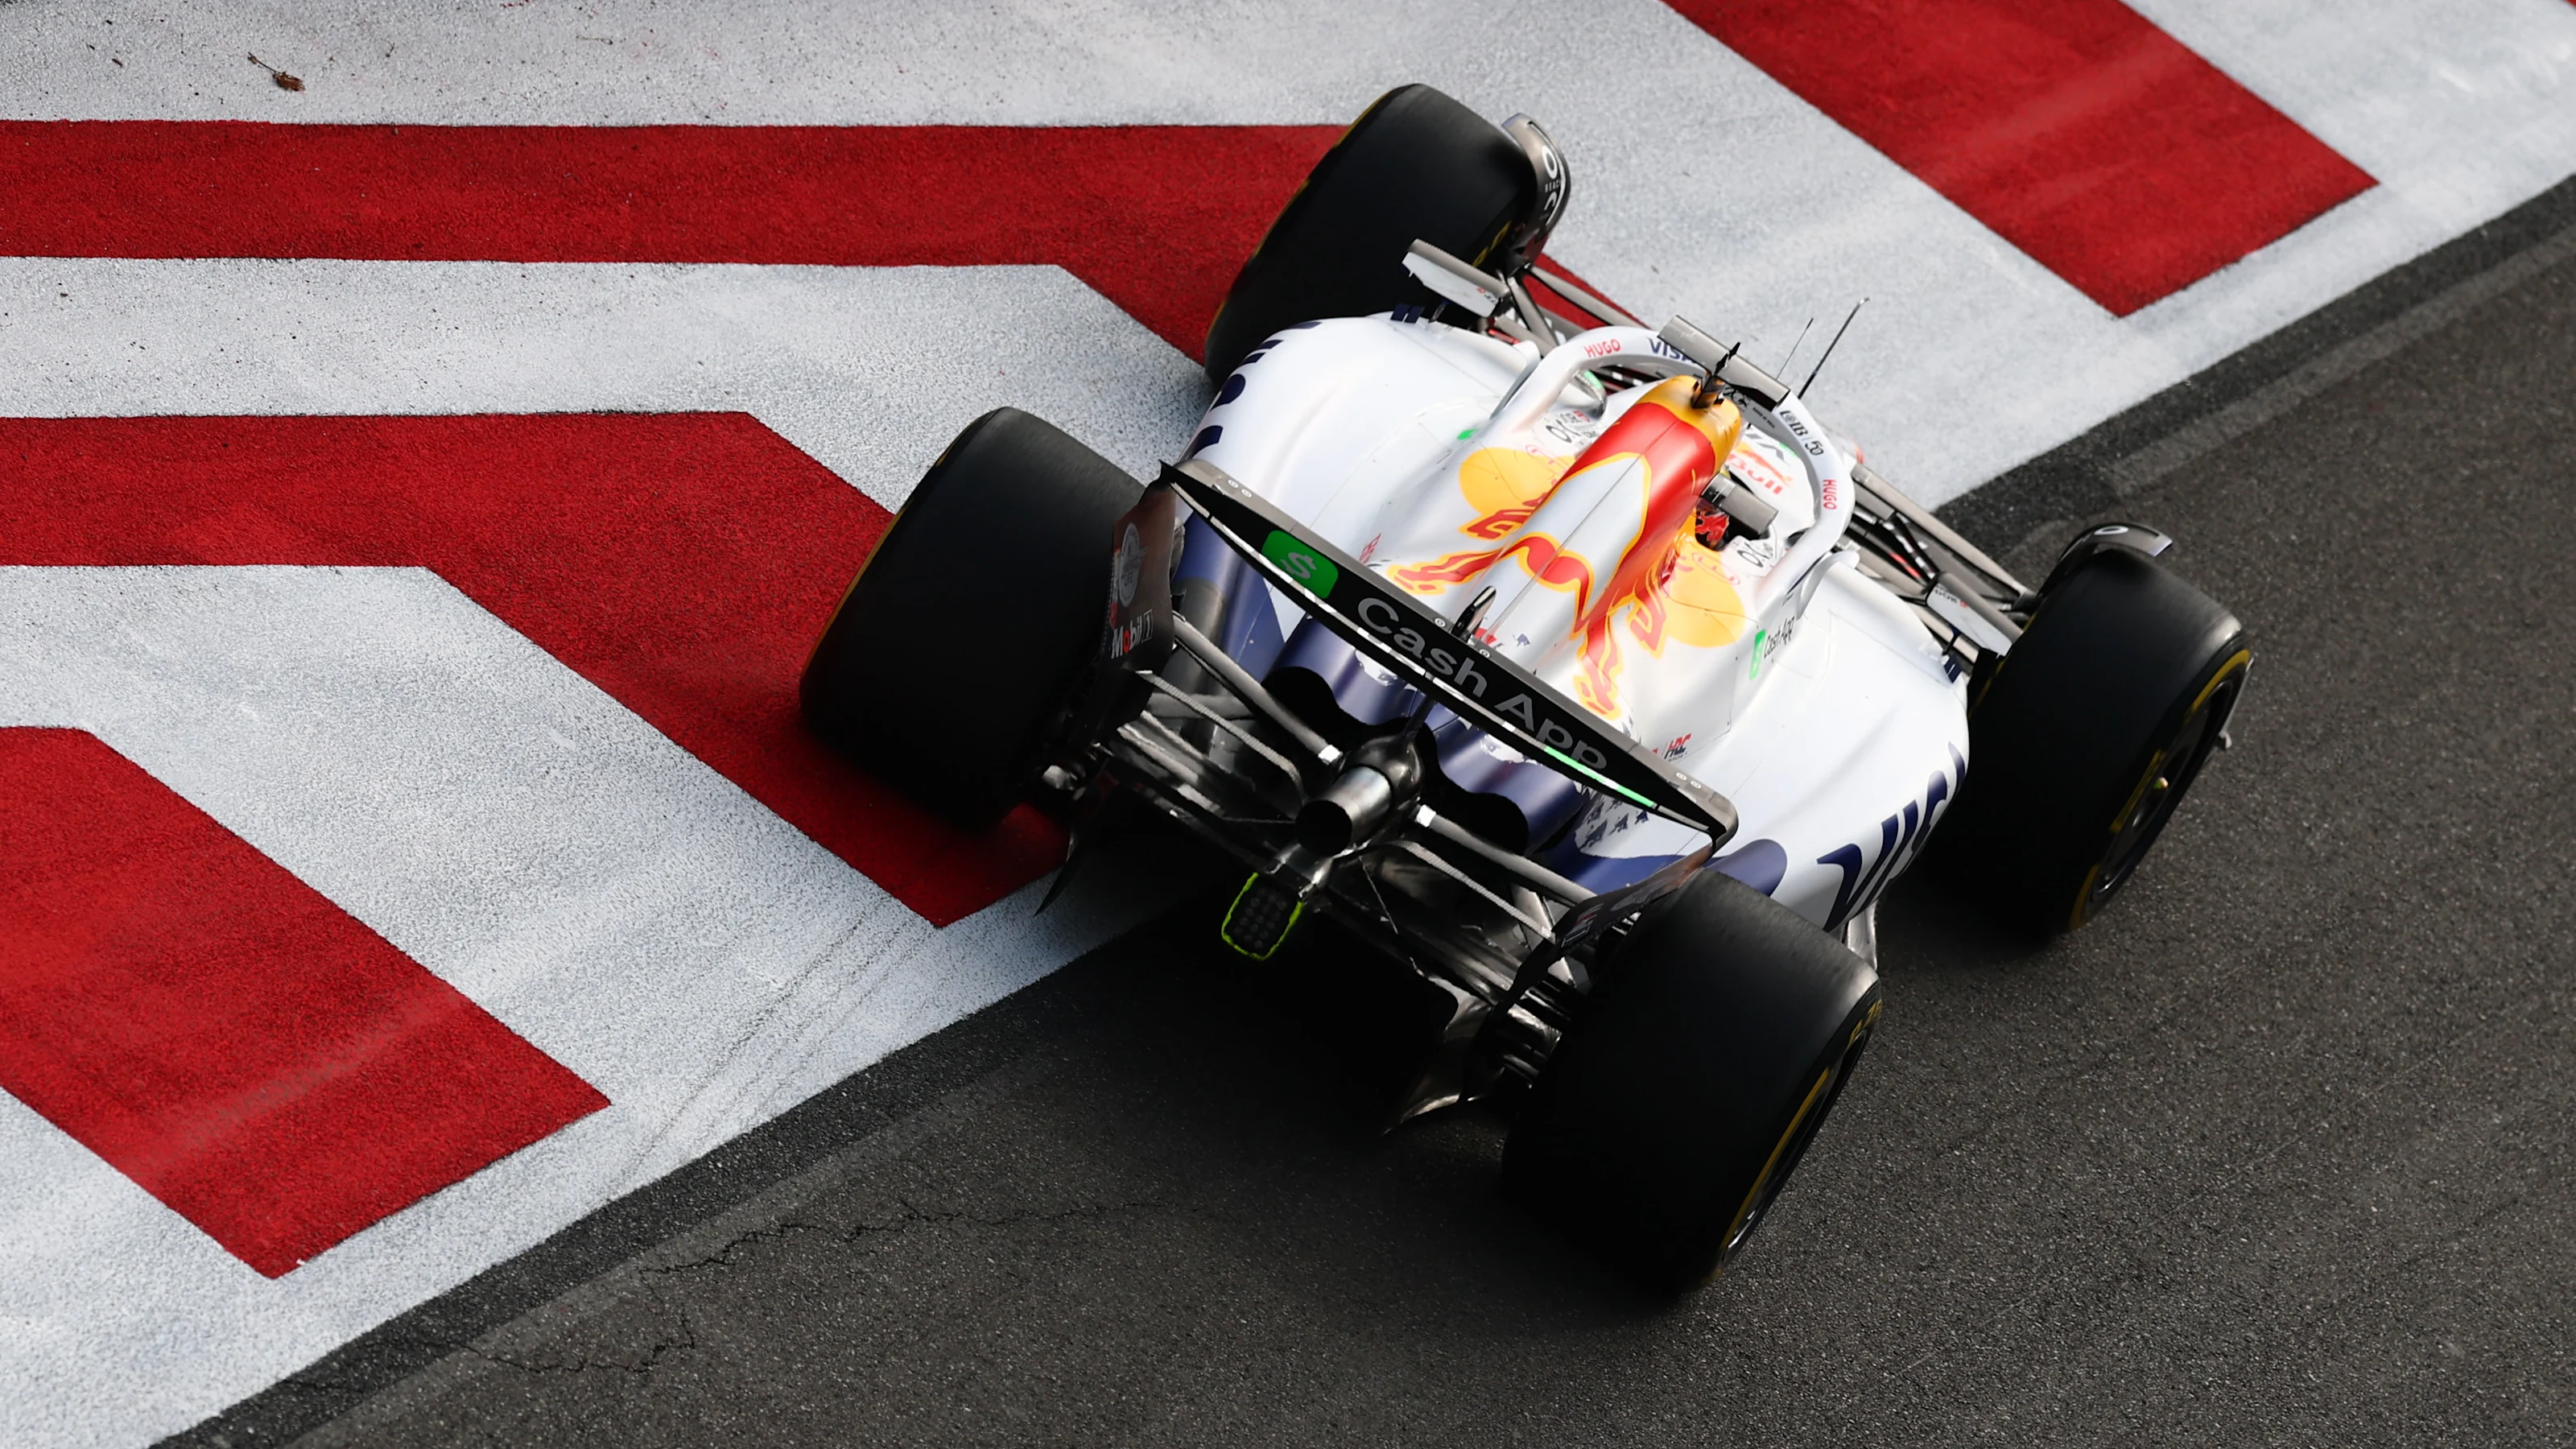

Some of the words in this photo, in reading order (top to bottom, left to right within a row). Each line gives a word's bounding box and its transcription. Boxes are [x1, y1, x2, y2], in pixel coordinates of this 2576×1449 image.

[1545, 180, 1562, 192] BEAC
[1583, 339, 1621, 358] HUGO
[1805, 440, 1824, 456] 50
[1823, 479, 1837, 510] HUGO
[1111, 615, 1143, 659] Mobil
[1357, 597, 1488, 698] Cash
[1493, 693, 1608, 770] App
